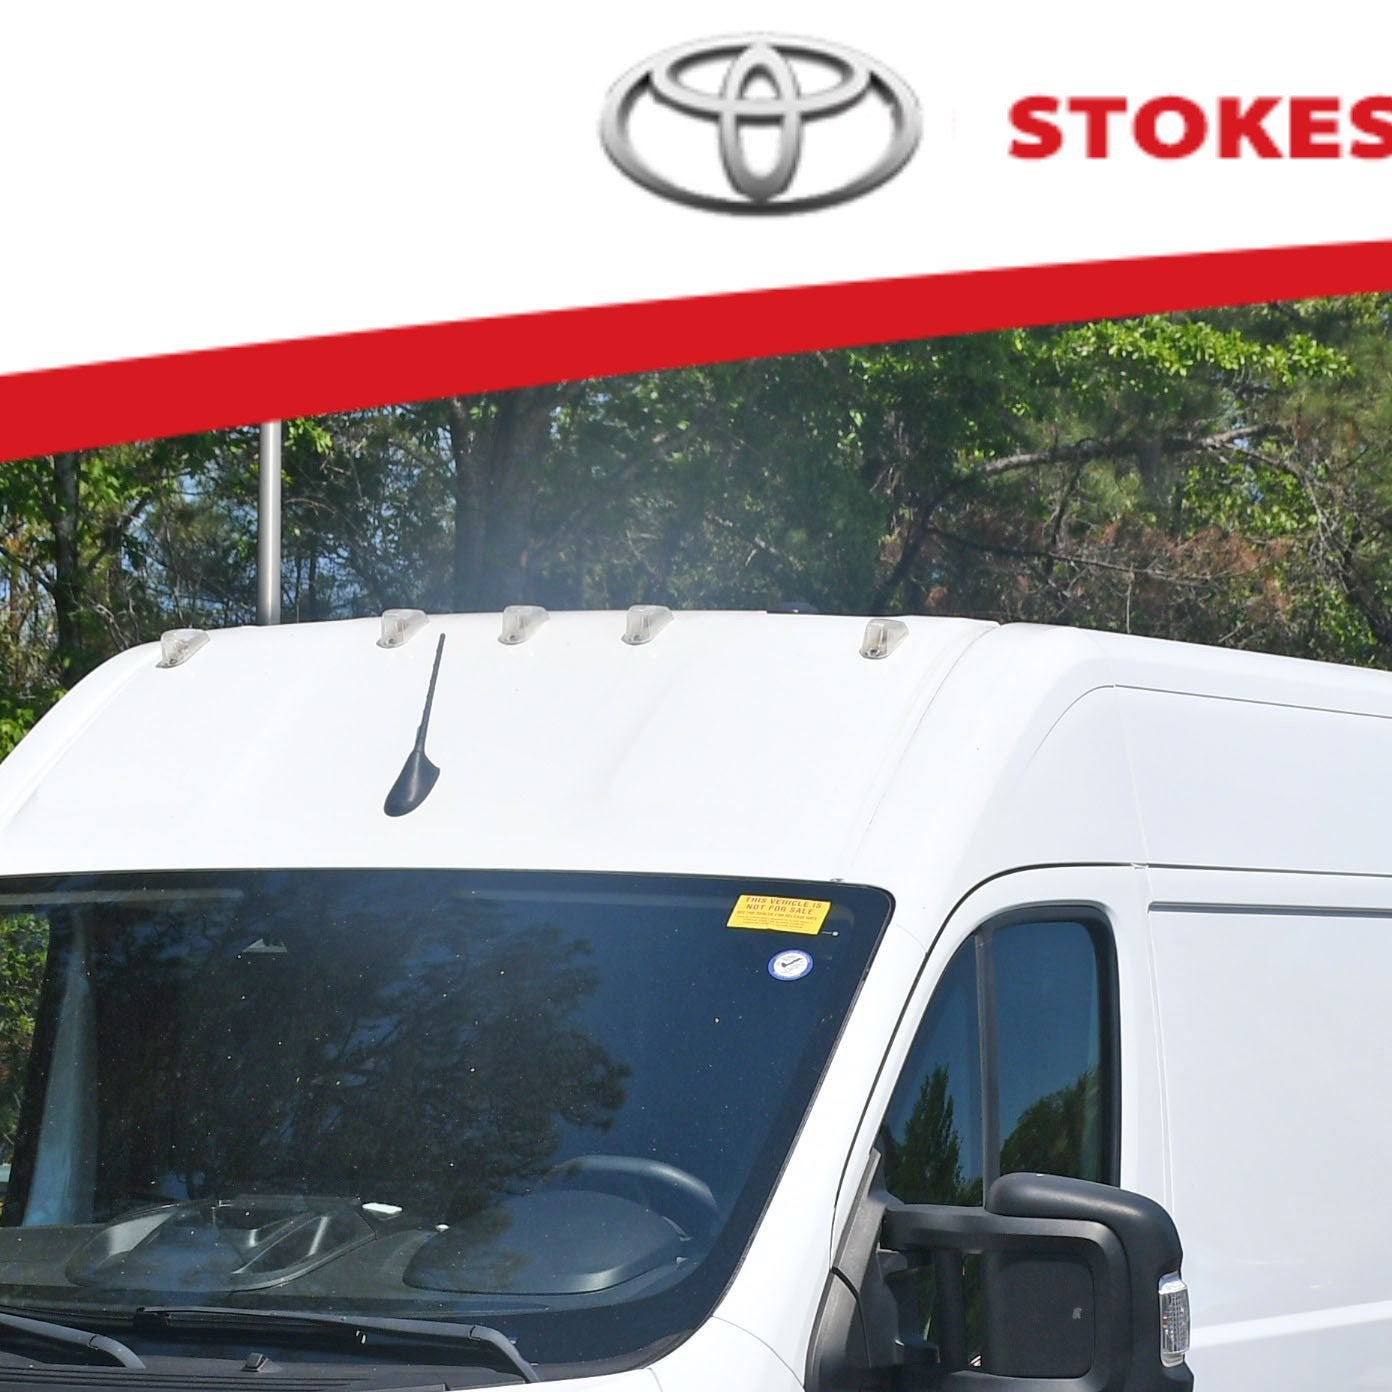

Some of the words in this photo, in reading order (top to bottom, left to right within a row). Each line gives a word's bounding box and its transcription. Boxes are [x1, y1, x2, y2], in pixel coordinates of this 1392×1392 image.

[770, 899, 810, 908] VEHICLE
[746, 903, 765, 911] NOT
[790, 906, 816, 915] SALE
